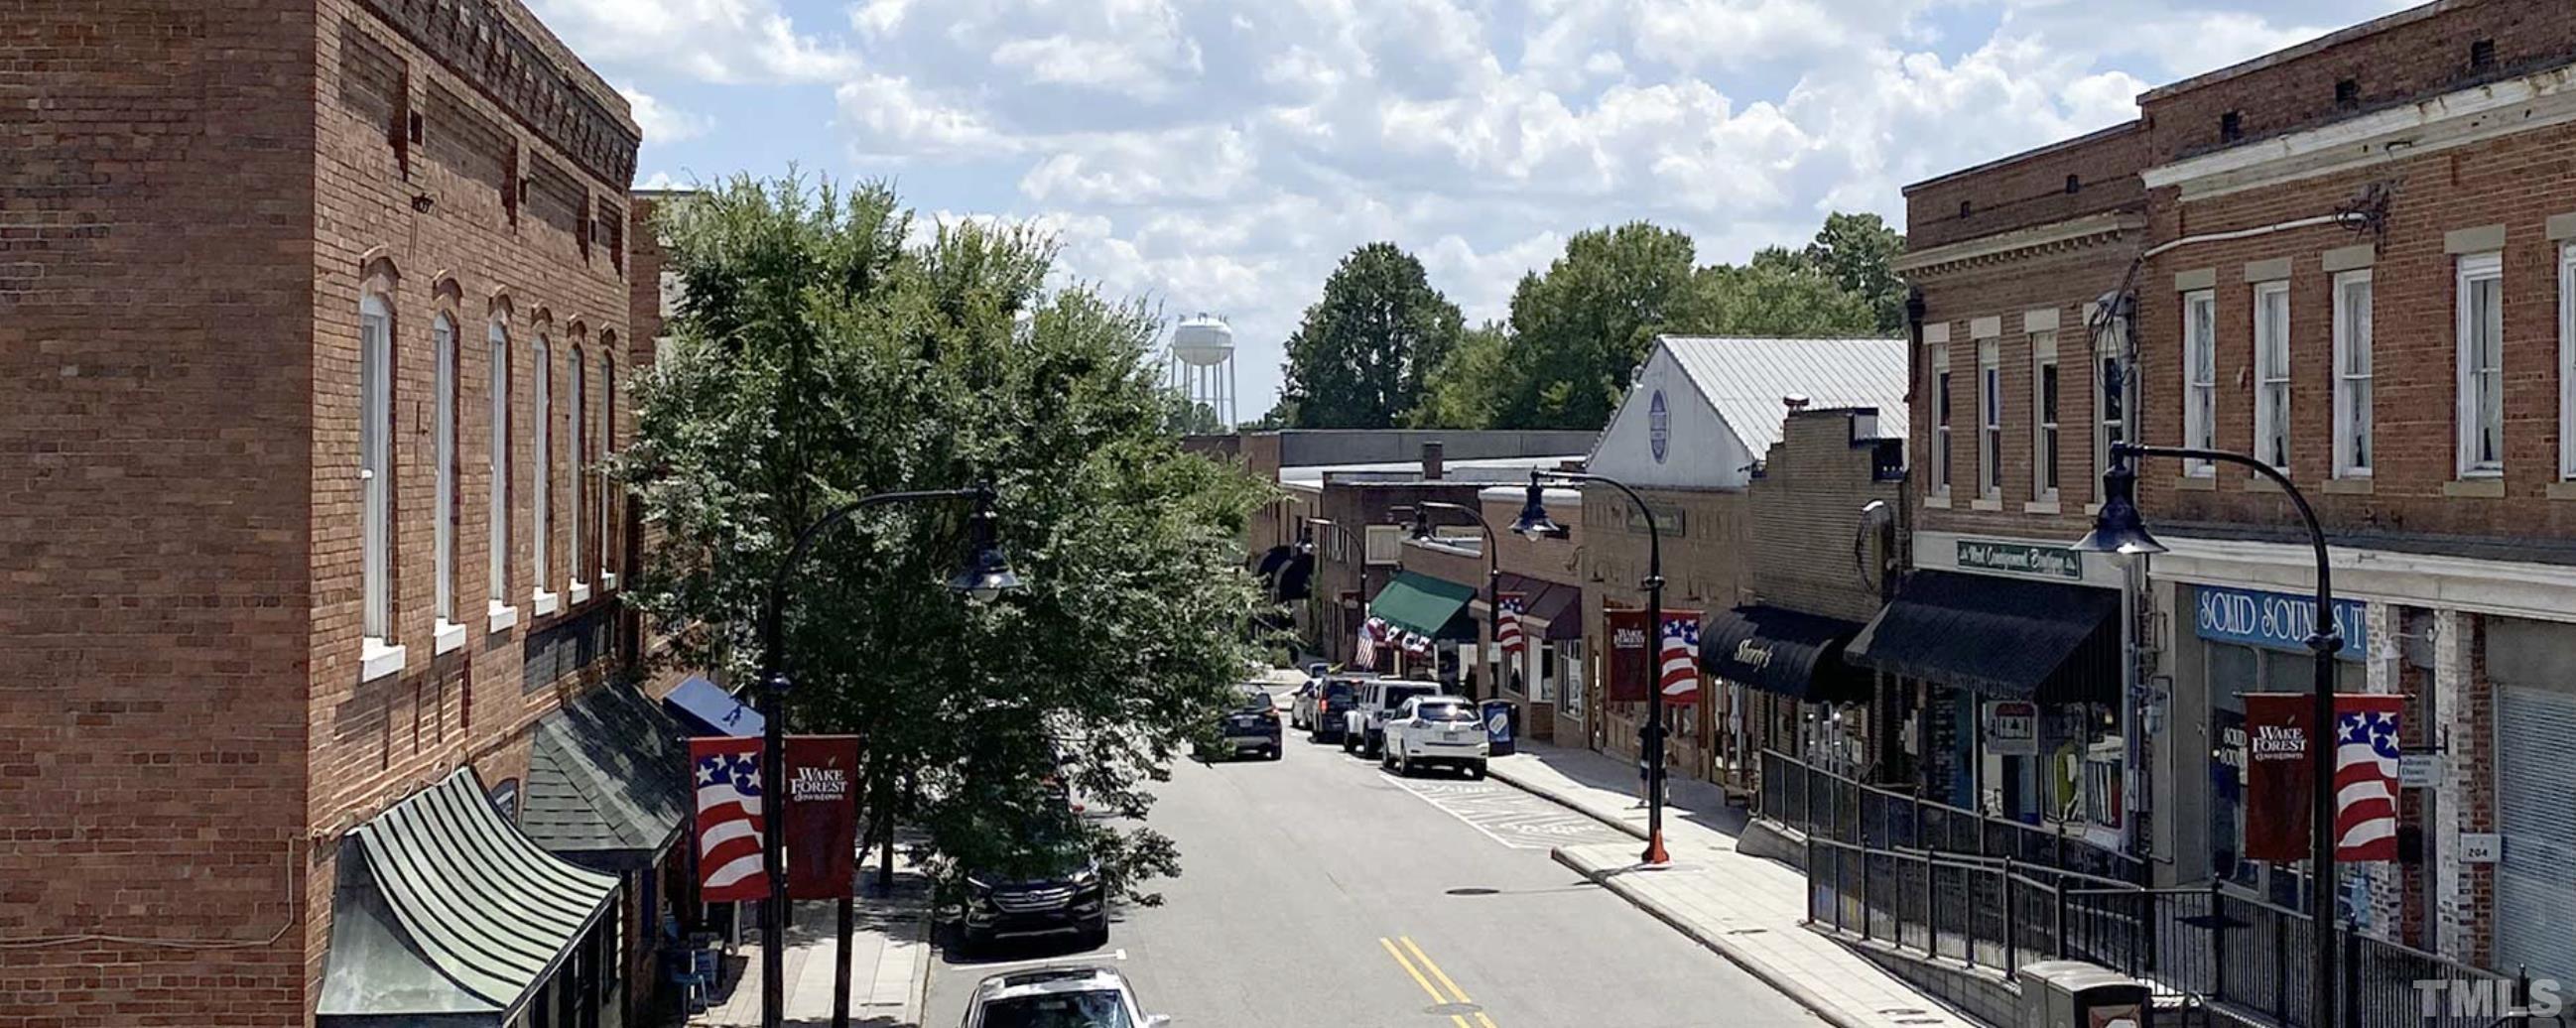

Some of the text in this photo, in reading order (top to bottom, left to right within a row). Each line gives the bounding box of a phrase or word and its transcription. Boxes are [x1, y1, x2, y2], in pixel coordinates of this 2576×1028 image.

[2200, 590, 2255, 634] SOLID
[2261, 596, 2346, 644] SOUNS
[1734, 638, 1773, 673] Shorty's
[2258, 725, 2303, 740] WAKE
[2252, 737, 2307, 753] FOREST
[798, 767, 843, 781] WAKE
[790, 779, 847, 793] FOREST
[2468, 848, 2488, 857] 204
